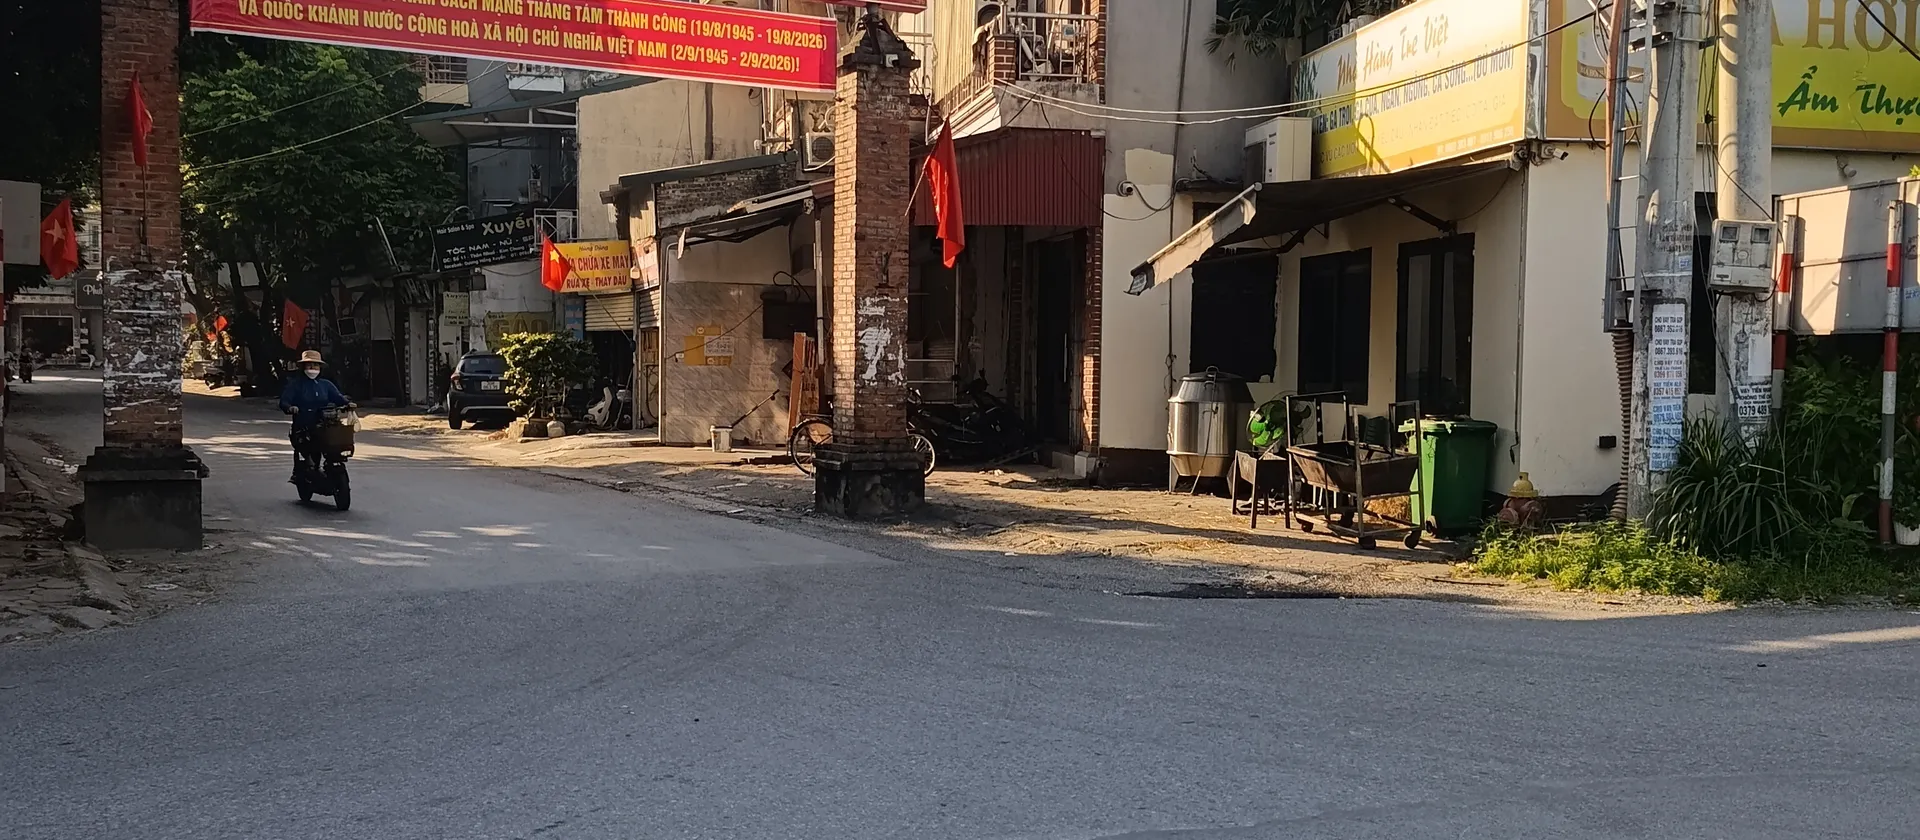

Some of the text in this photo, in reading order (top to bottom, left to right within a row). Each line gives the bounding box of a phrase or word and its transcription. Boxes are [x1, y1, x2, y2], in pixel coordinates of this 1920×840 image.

[527, 0, 571, 21] THÁNG
[575, 3, 603, 25] TÁM
[606, 8, 649, 30] THÀNH
[652, 13, 687, 34] CÔNG
[690, 19, 755, 42] (19/8/1945
[765, 28, 827, 51] 19/8/2026)
[308, 3, 359, 27] KHÁNH
[363, 9, 403, 31] NƯỚC
[408, 12, 447, 37] CỘNG
[451, 18, 480, 39] HOÀ
[483, 21, 502, 41] XÃ
[505, 23, 529, 47] HỘI
[532, 25, 559, 47] CHỦ
[563, 32, 604, 52] NGHĨA
[607, 35, 635, 58] VIỆT
[637, 40, 667, 59] NAM
[671, 44, 729, 65] (2/9/1945
[739, 51, 800, 73] 2/9/2026)!
[1399, 25, 1418, 61] Tre
[1423, 13, 1449, 58] Việt
[1777, 65, 1920, 125] Ẩm Thự
[436, 227, 447, 235] Hair
[447, 224, 460, 233] Salon
[465, 223, 475, 231] Spa
[446, 247, 466, 256] TÓC
[468, 243, 490, 252] NAM
[601, 256, 611, 270] XE
[612, 252, 629, 269] MÁY
[566, 276, 580, 289] RỬA
[581, 277, 590, 288] XE
[594, 276, 612, 287] THAY
[613, 273, 627, 286] DẦU
[1739, 405, 1756, 416] 0379
